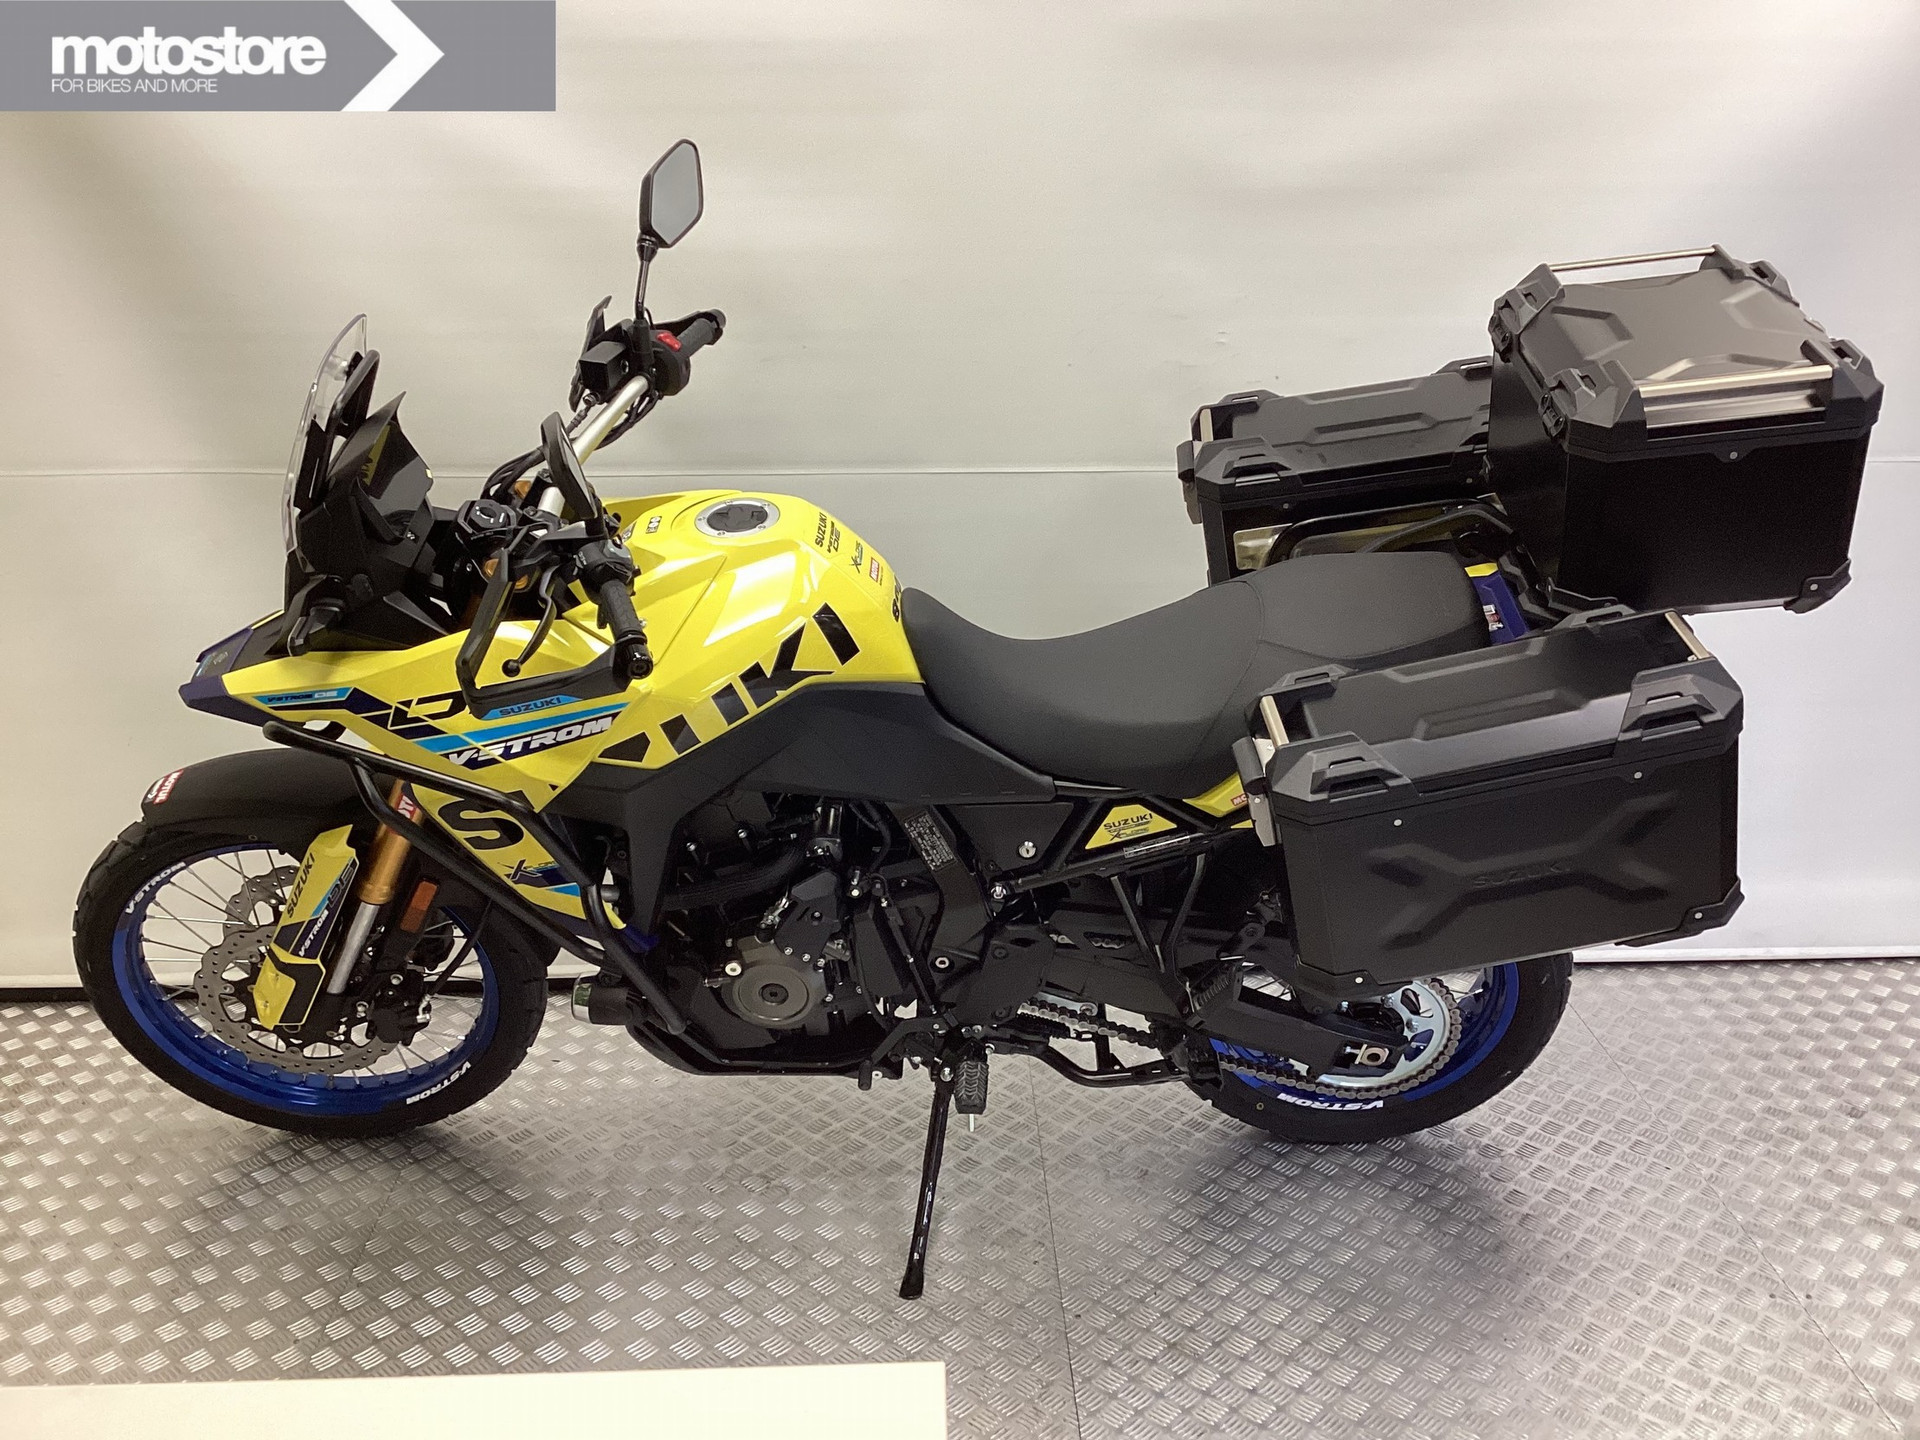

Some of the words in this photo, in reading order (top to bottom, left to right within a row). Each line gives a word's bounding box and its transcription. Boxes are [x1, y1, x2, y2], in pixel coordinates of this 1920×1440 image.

[815, 512, 827, 547] SUZUKI
[499, 697, 562, 717] SUZUKI
[448, 716, 613, 765] V-STROM
[1103, 813, 1153, 830] SUZUKI
[125, 861, 187, 914] V-STROM
[287, 852, 315, 919] SUZUKI
[298, 908, 329, 957] V-STROM
[405, 1060, 472, 1105] V-STROM
[1276, 1092, 1384, 1111] V-STROM
